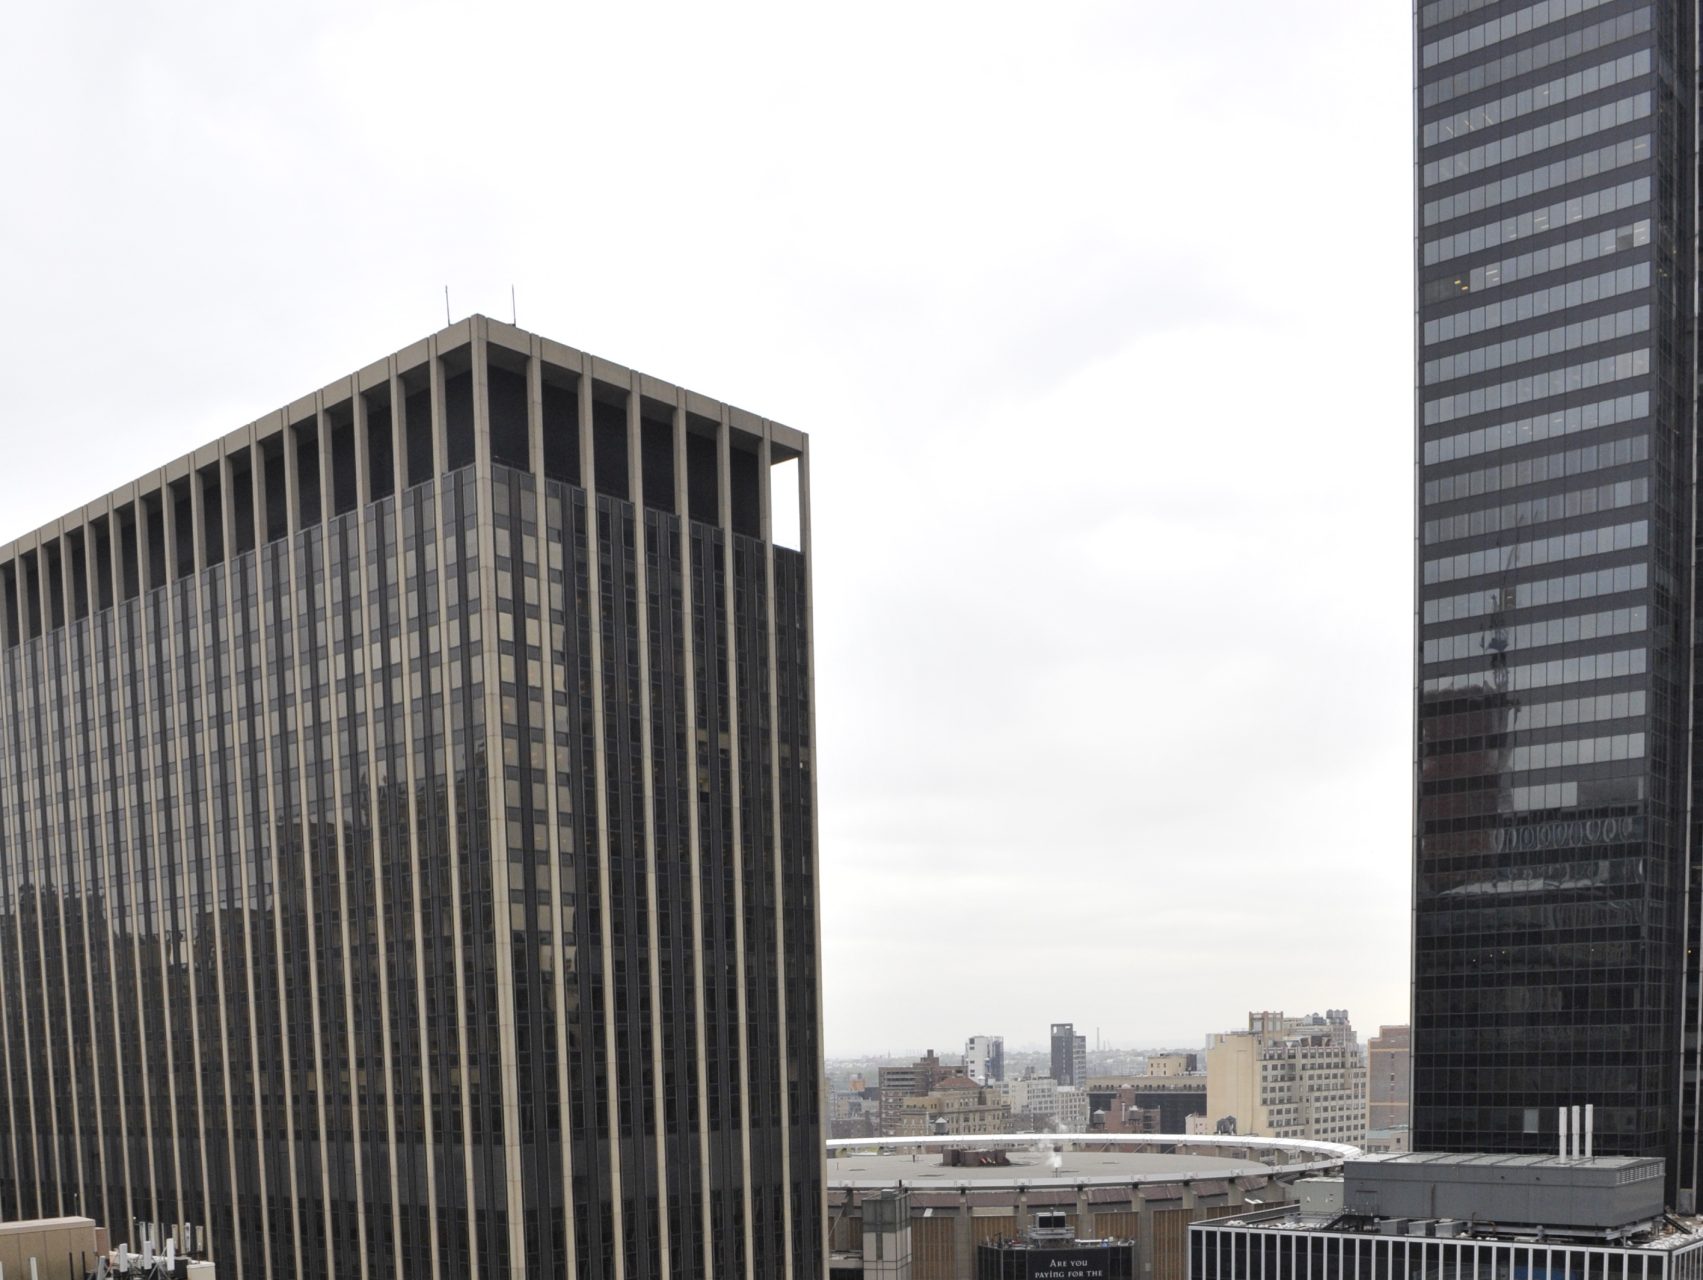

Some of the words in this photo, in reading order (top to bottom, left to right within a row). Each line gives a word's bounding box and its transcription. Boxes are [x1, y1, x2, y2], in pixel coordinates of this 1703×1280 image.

[1050, 1259, 1067, 1267] ARE
[1070, 1259, 1088, 1267] YOU
[1068, 1270, 1084, 1278] FOR
